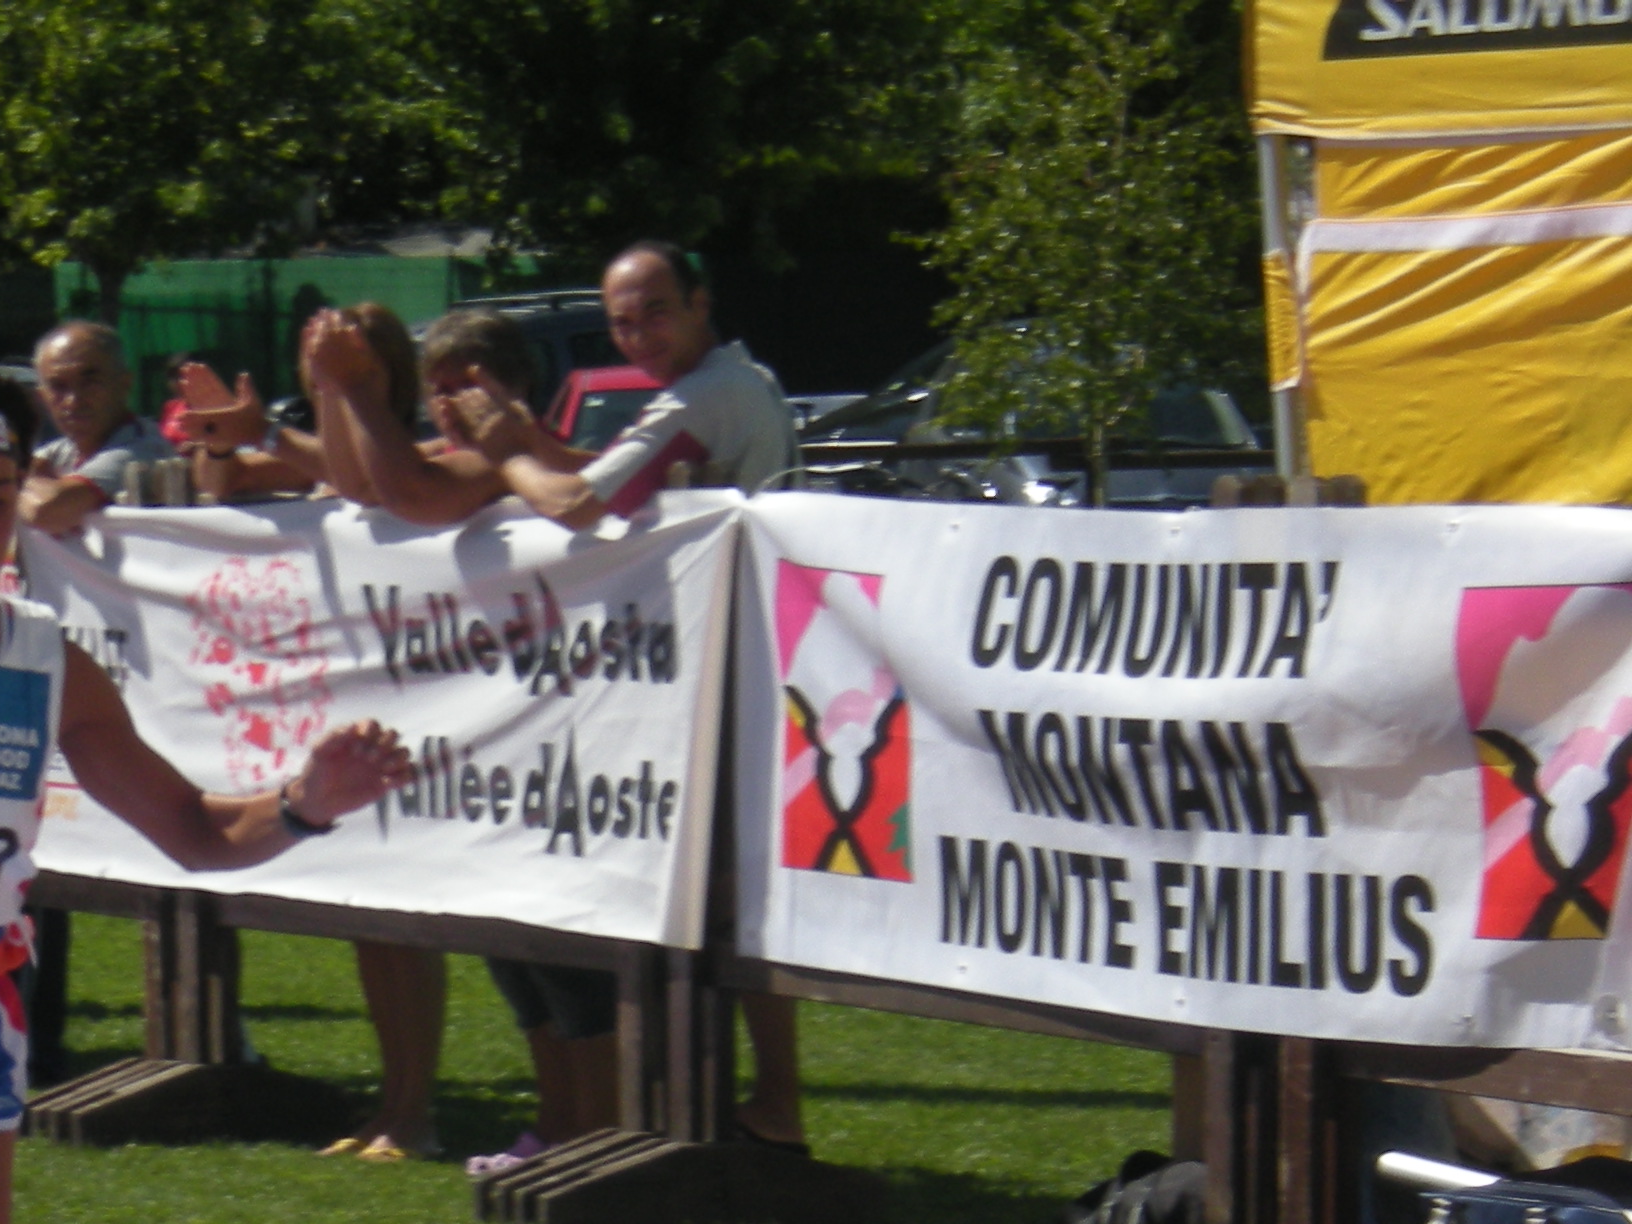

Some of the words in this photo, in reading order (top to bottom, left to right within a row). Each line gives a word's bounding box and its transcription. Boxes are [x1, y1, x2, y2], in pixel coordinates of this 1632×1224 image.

[360, 584, 500, 689] Valle
[971, 554, 1340, 679] COMUNITA'
[978, 709, 1328, 838] MONTANA
[937, 835, 1136, 969] MONTE
[1157, 861, 1436, 997] EMILIUS
